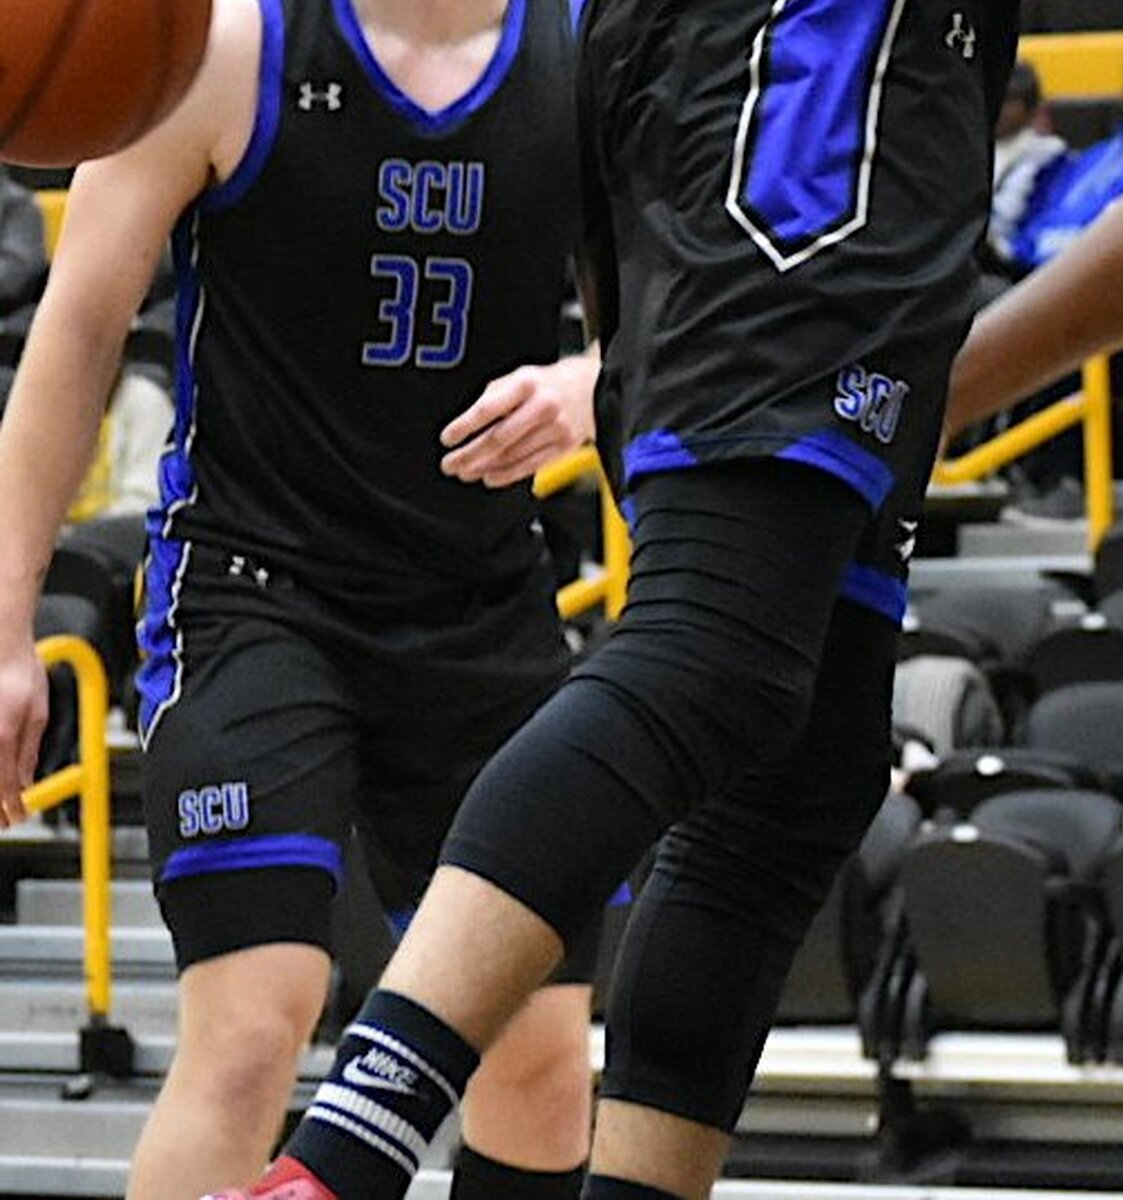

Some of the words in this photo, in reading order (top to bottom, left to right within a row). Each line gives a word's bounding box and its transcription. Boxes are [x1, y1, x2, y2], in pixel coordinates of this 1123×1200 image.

[376, 158, 485, 235] SCU
[361, 254, 474, 368] 33
[178, 782, 249, 838] SCU
[361, 1047, 417, 1085] NIKE
